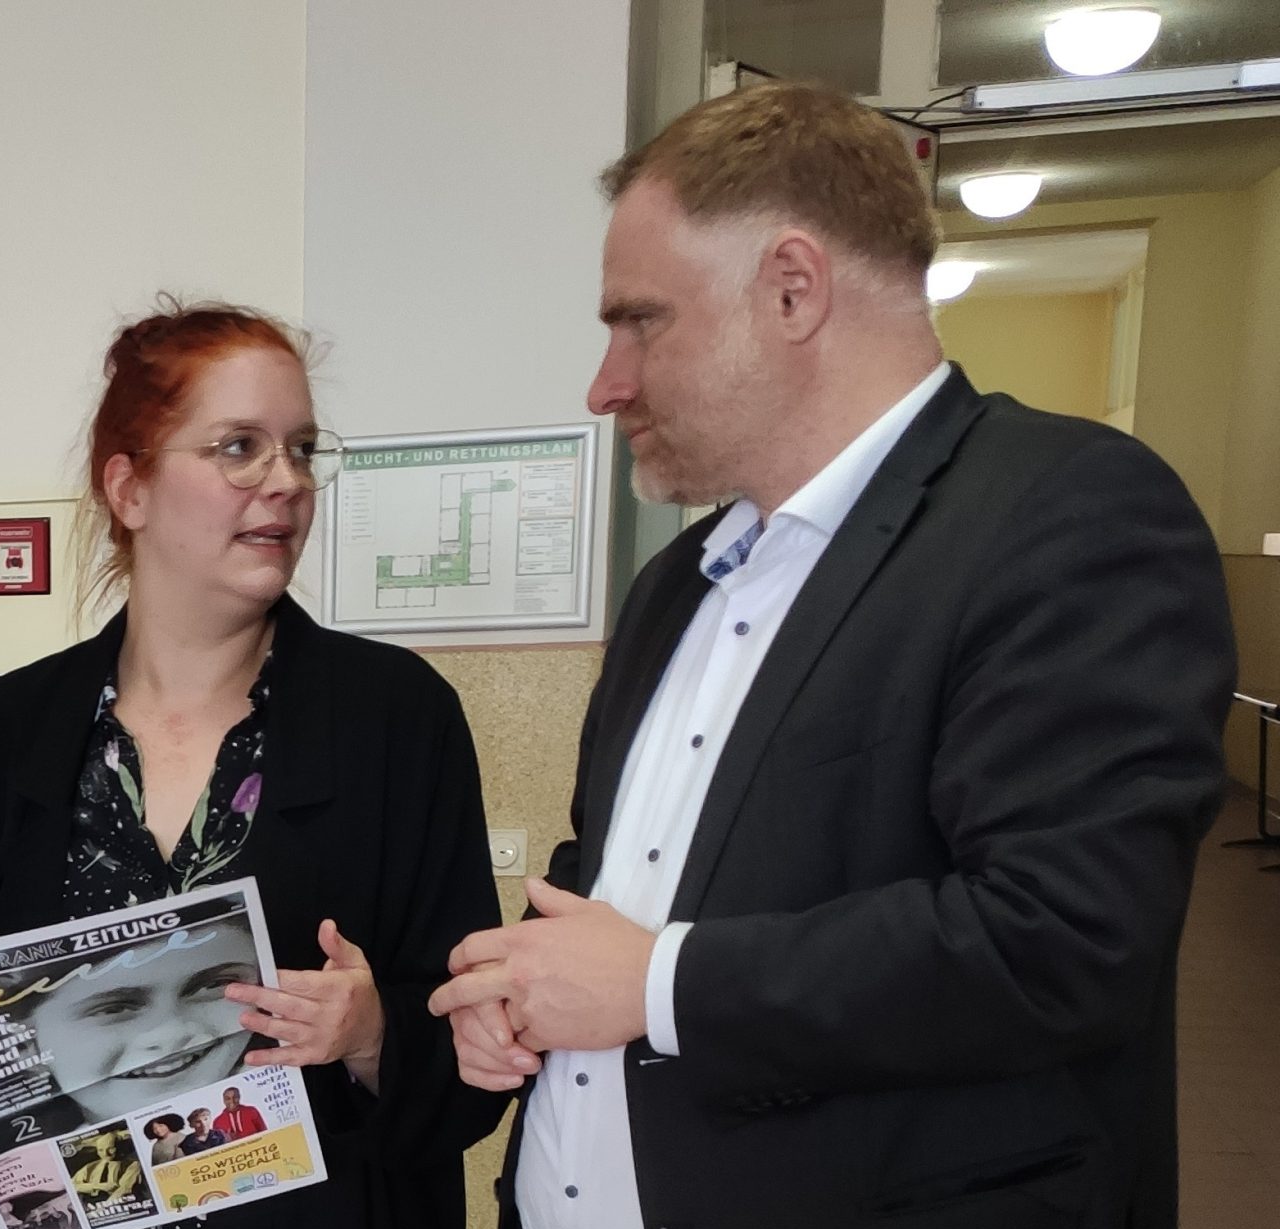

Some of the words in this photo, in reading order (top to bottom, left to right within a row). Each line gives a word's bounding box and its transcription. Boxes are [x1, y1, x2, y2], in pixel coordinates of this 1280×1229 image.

[346, 453, 409, 466] FLUCHT-
[413, 450, 447, 462] UND
[449, 442, 573, 460] RETTUNGSPLAN
[70, 912, 181, 951] ZEITUNG
[190, 1165, 211, 1177] SO
[215, 1143, 278, 1169] WICHTIG
[192, 1169, 226, 1184] SIND
[231, 1150, 281, 1174] IDEALE
